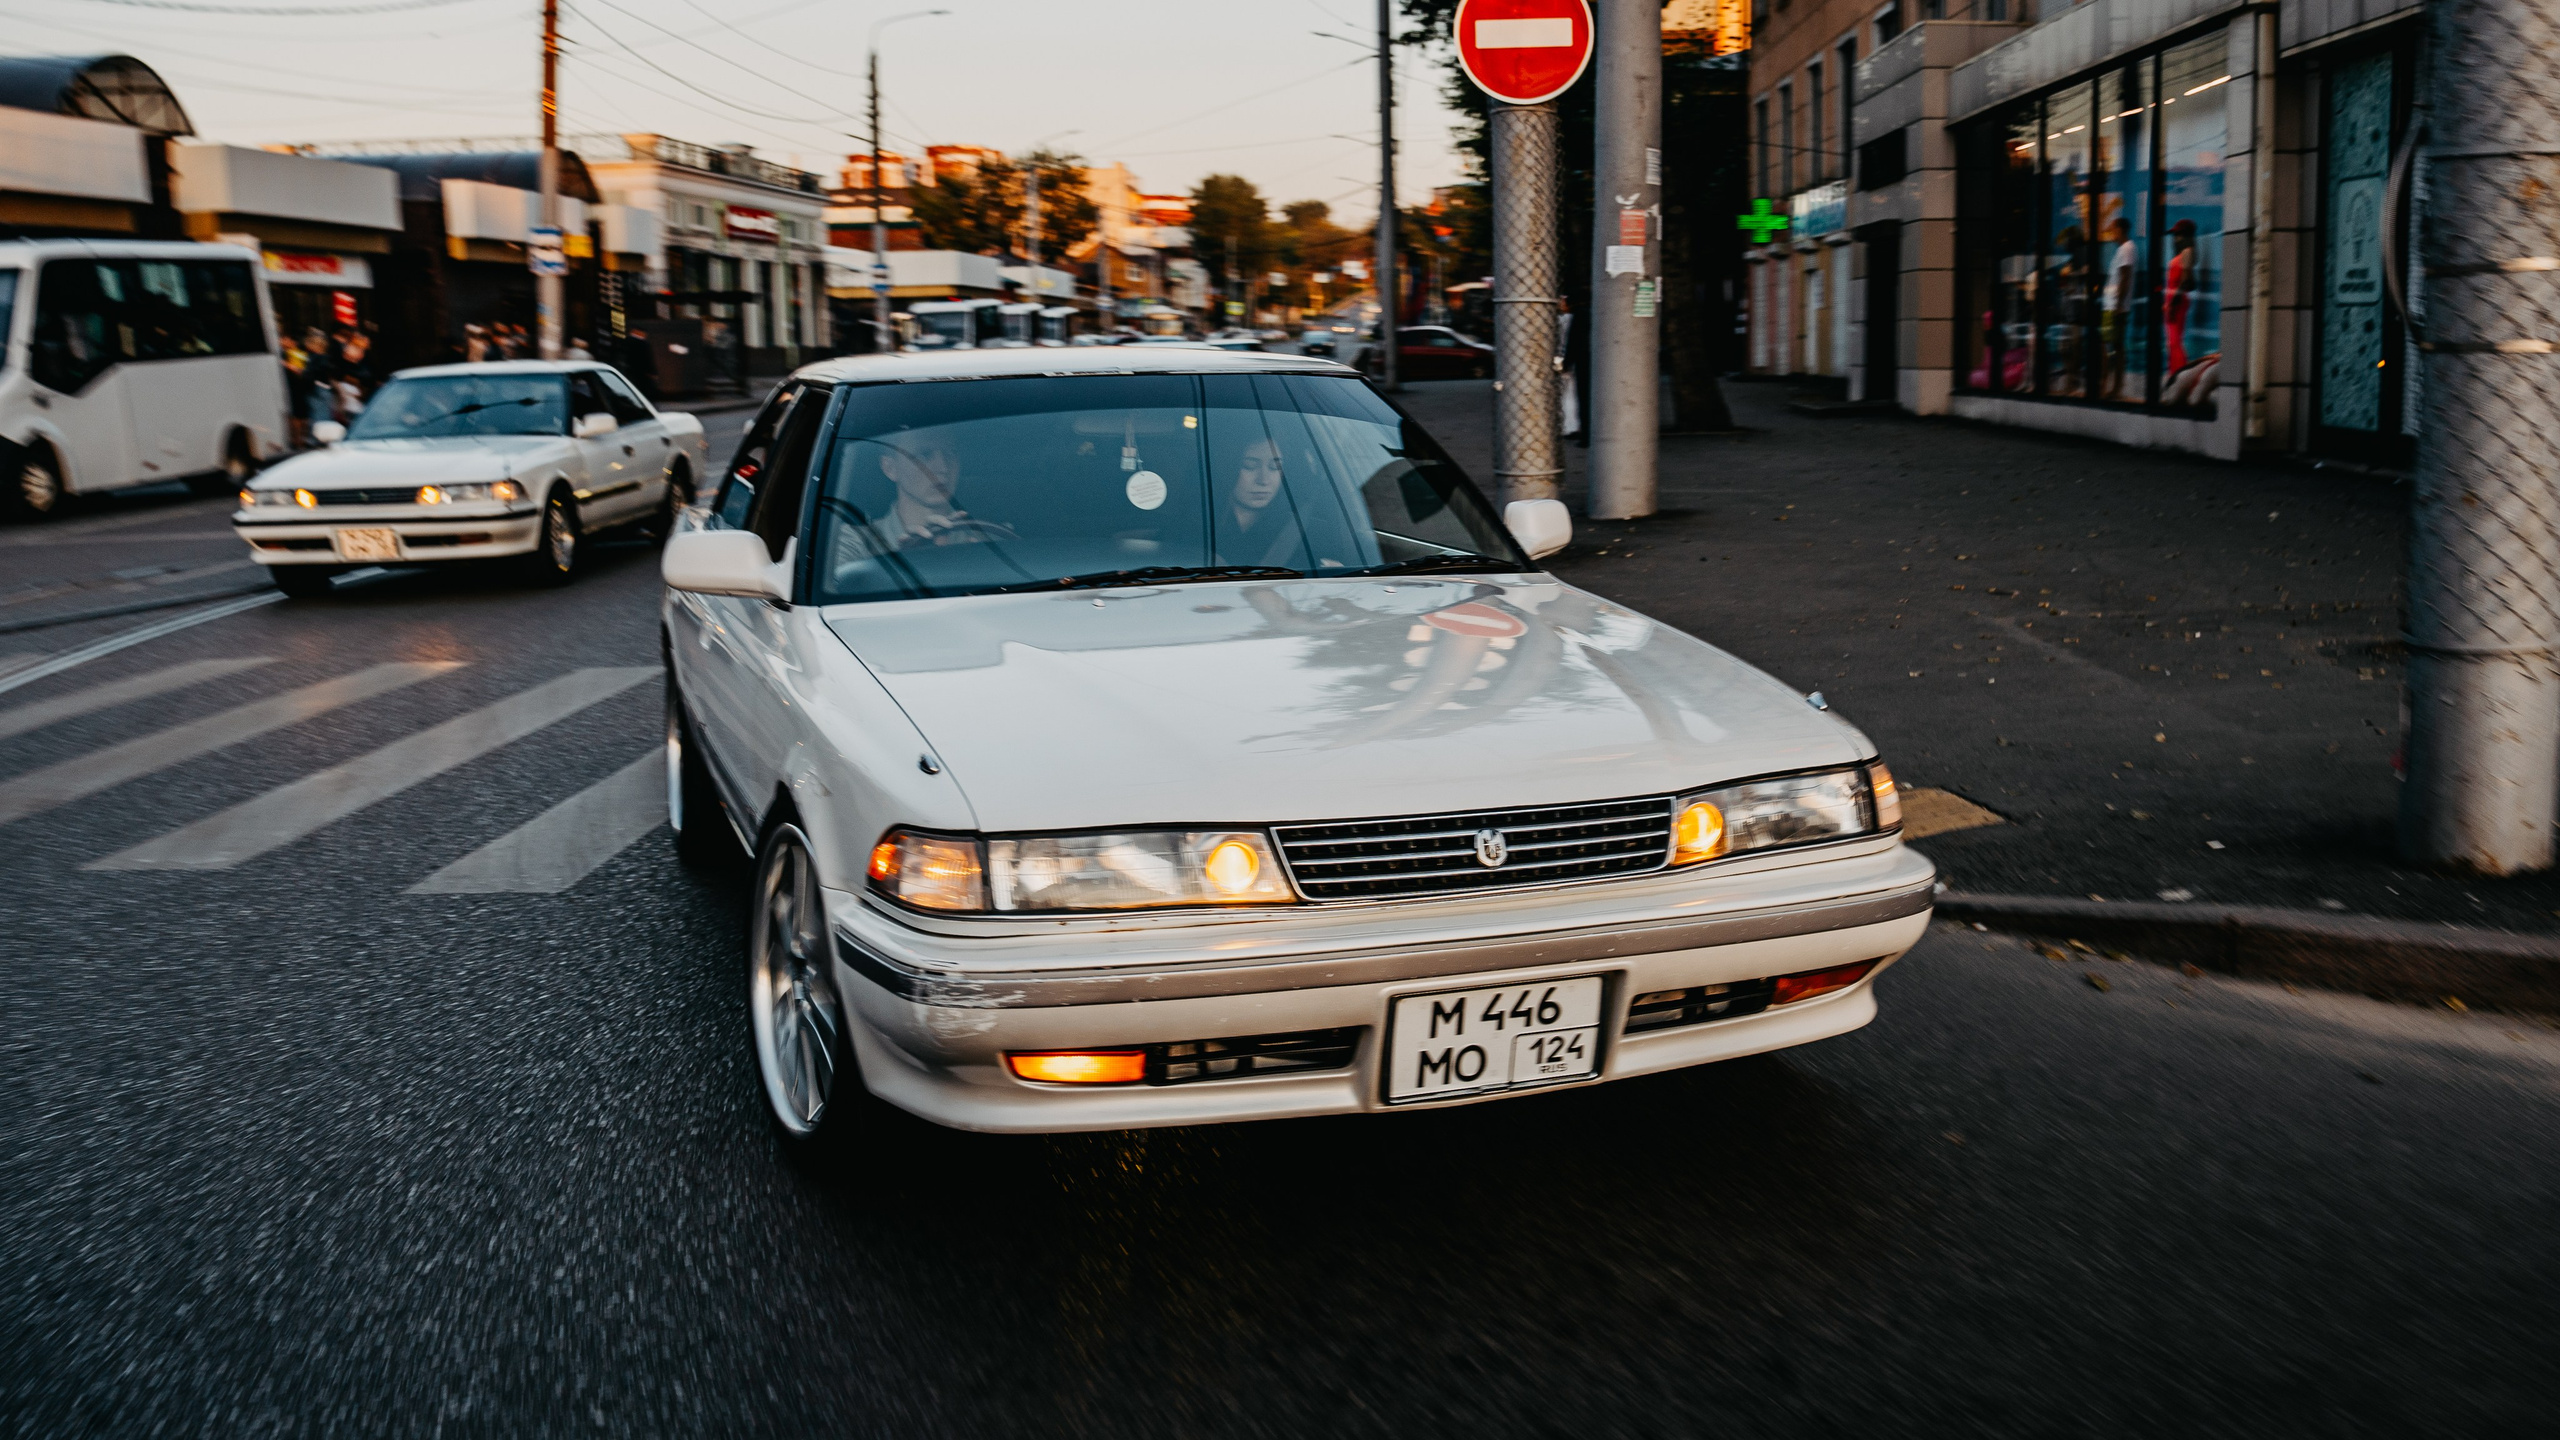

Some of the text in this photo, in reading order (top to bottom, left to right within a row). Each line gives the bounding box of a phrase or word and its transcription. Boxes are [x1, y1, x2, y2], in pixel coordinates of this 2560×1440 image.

[1429, 987, 1562, 1039] M 446
[1416, 1044, 1488, 1088] MO
[1529, 1032, 1585, 1065] 124
